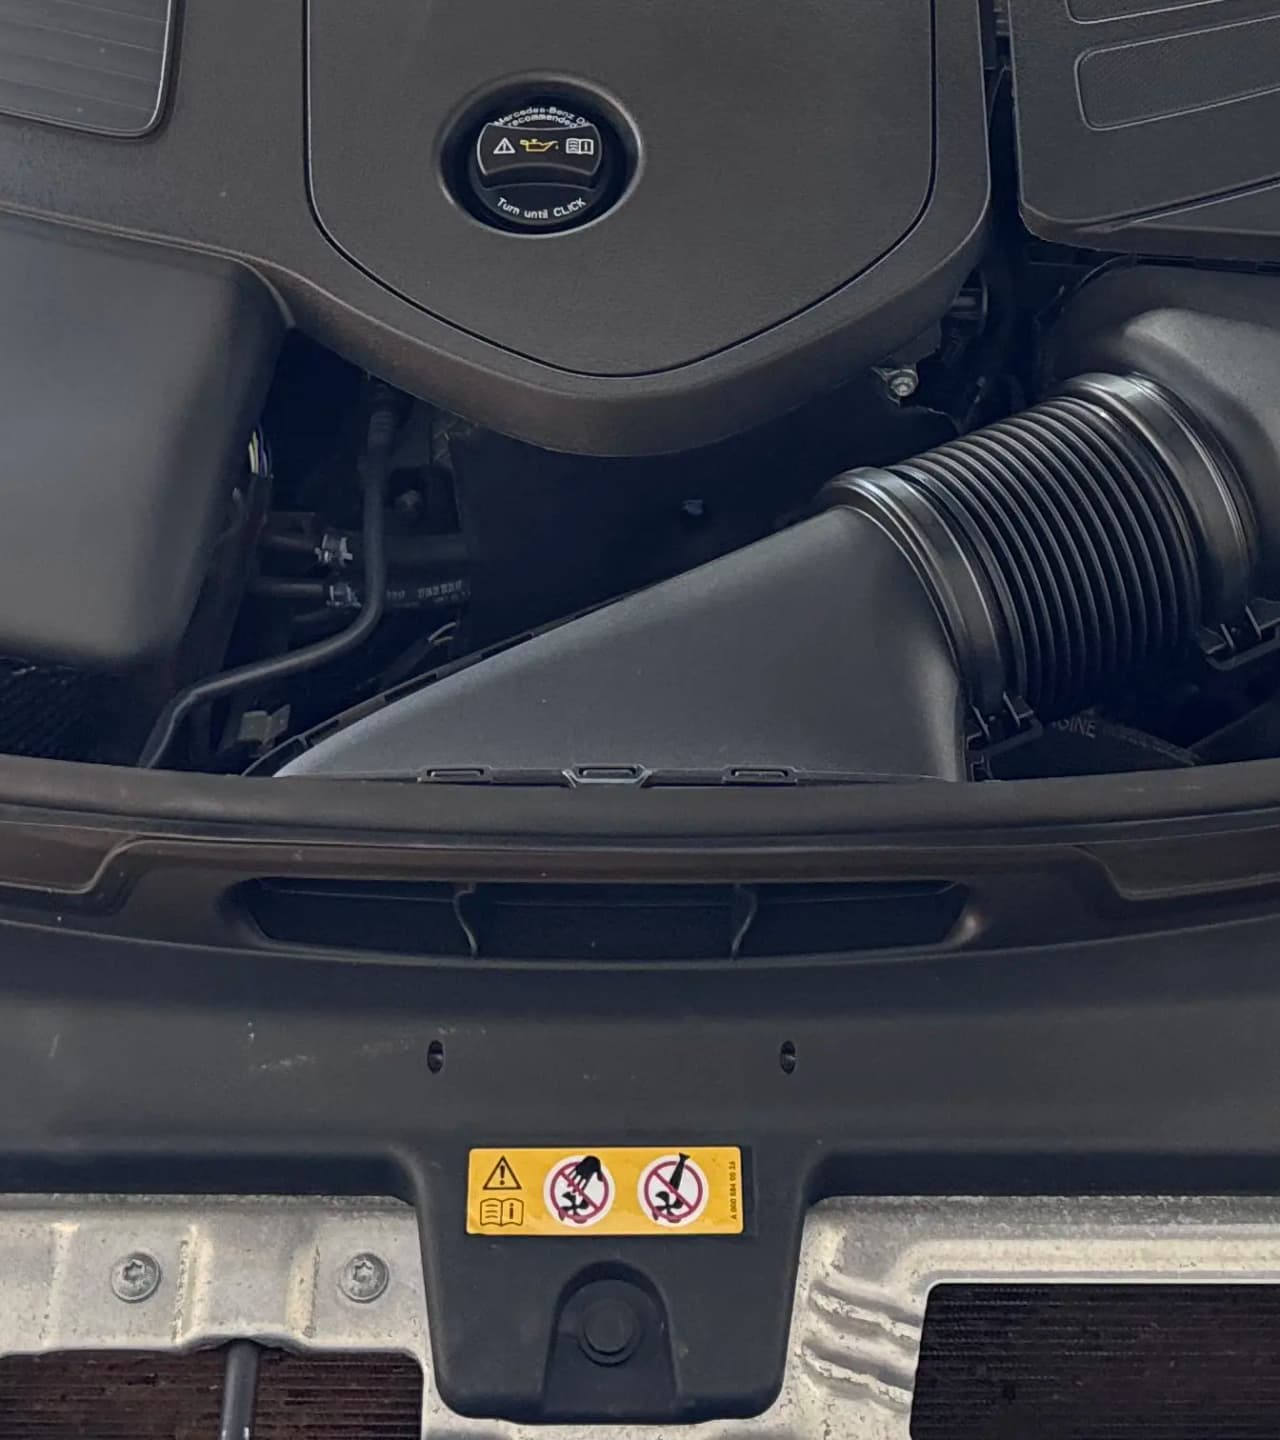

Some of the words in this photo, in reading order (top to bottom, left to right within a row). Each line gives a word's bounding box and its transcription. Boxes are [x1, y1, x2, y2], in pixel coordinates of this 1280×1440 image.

[497, 197, 520, 216] Turn
[524, 209, 548, 219] until
[553, 197, 586, 217] CLICK
